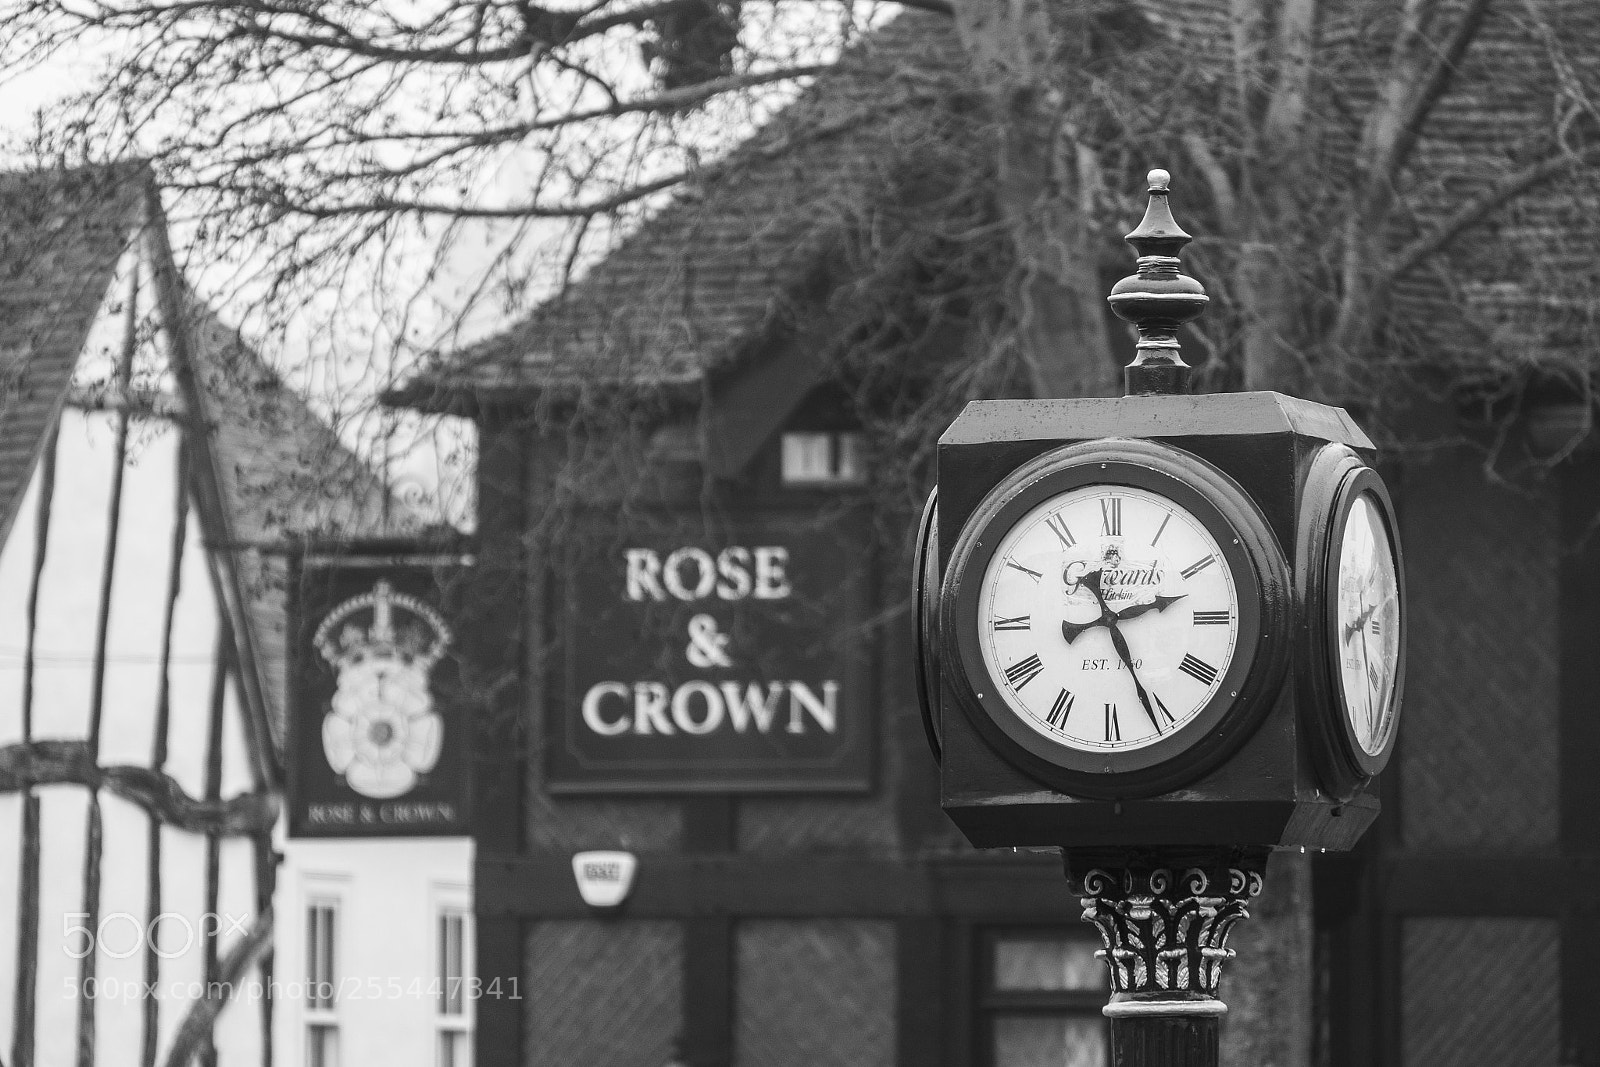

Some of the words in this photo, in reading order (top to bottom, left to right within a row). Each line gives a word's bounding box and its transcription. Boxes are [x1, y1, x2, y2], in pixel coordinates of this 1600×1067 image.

[1045, 512, 1077, 552] XI
[1100, 497, 1122, 536] XII
[624, 545, 791, 601] ROSE
[1062, 559, 1165, 596] Gwards
[1179, 553, 1216, 580] II
[1193, 610, 1230, 627] III
[686, 612, 733, 668] &
[1081, 658, 1110, 671] EST.
[581, 679, 840, 735] CROWN
[308, 803, 353, 824] ROSE
[359, 803, 378, 824] &
[379, 803, 455, 824] CROWN
